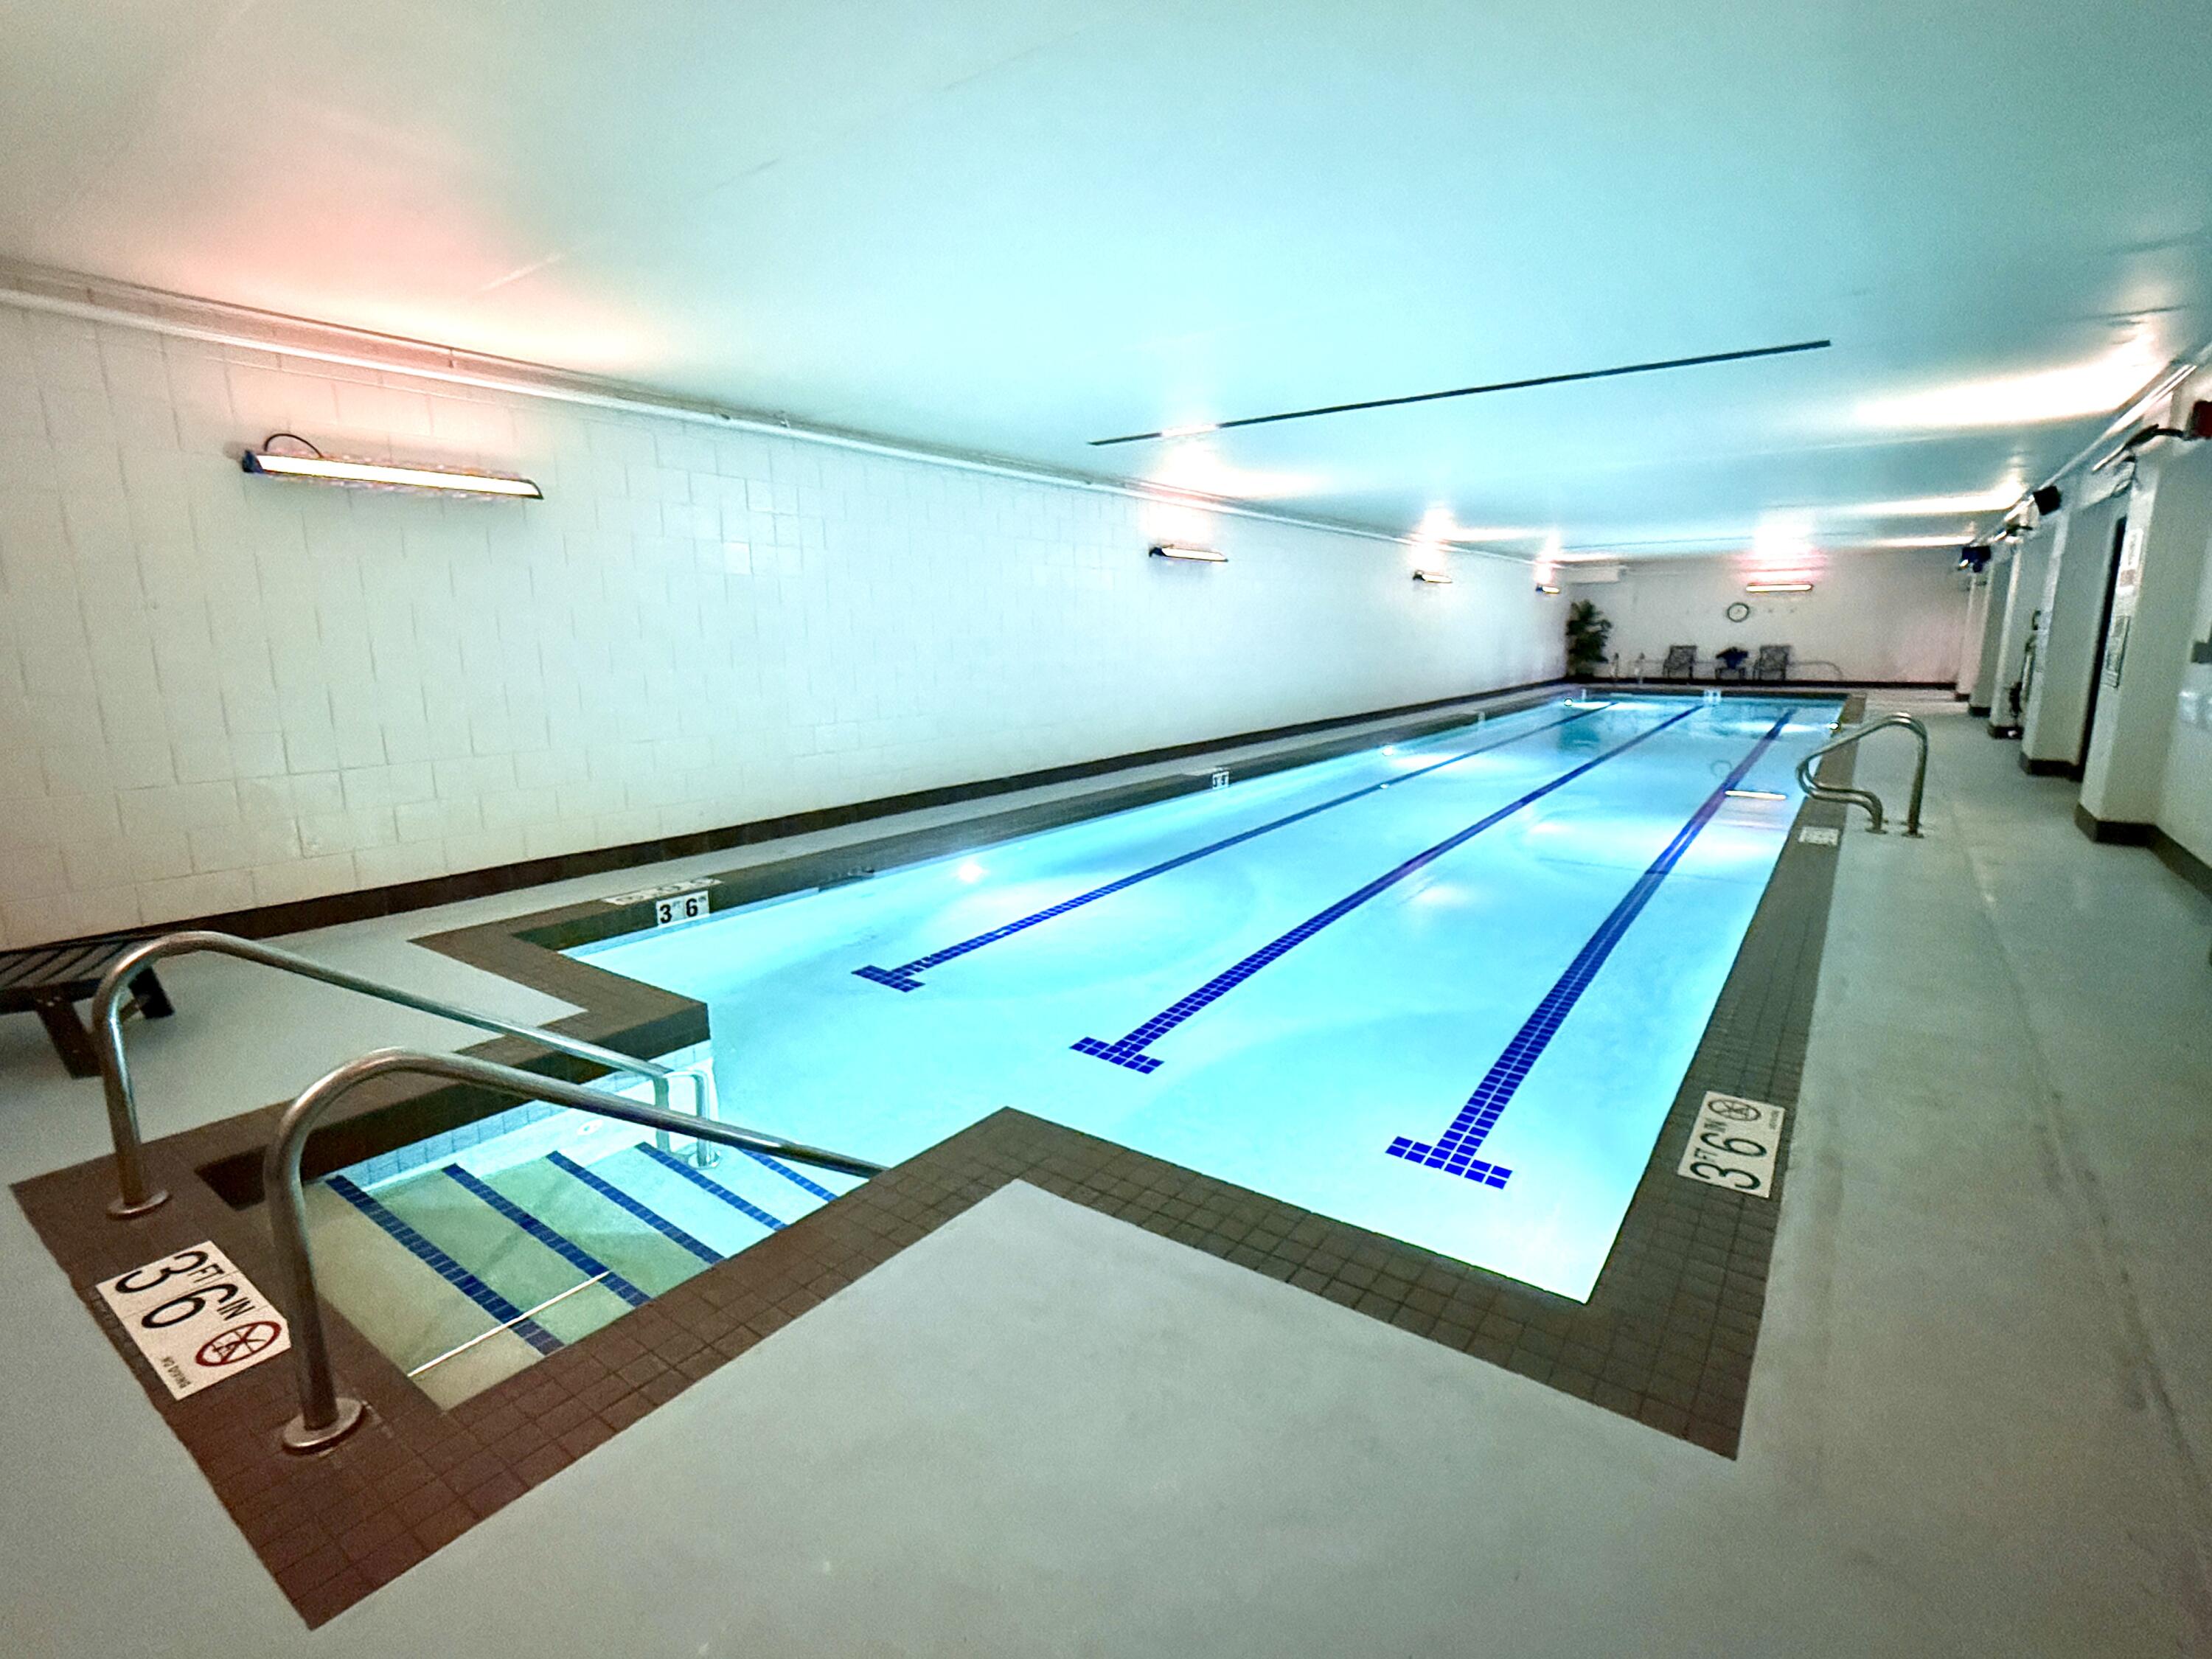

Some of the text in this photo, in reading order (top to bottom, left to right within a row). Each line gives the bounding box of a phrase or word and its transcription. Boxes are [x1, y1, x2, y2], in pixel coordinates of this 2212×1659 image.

[660, 904, 672, 923] 3
[686, 898, 698, 917] 6
[1694, 1147, 1717, 1162] FT
[1700, 1133, 1767, 1156] 6
[1690, 1161, 1761, 1190] 3
[115, 1251, 256, 1329] 3 FT 6 IN
